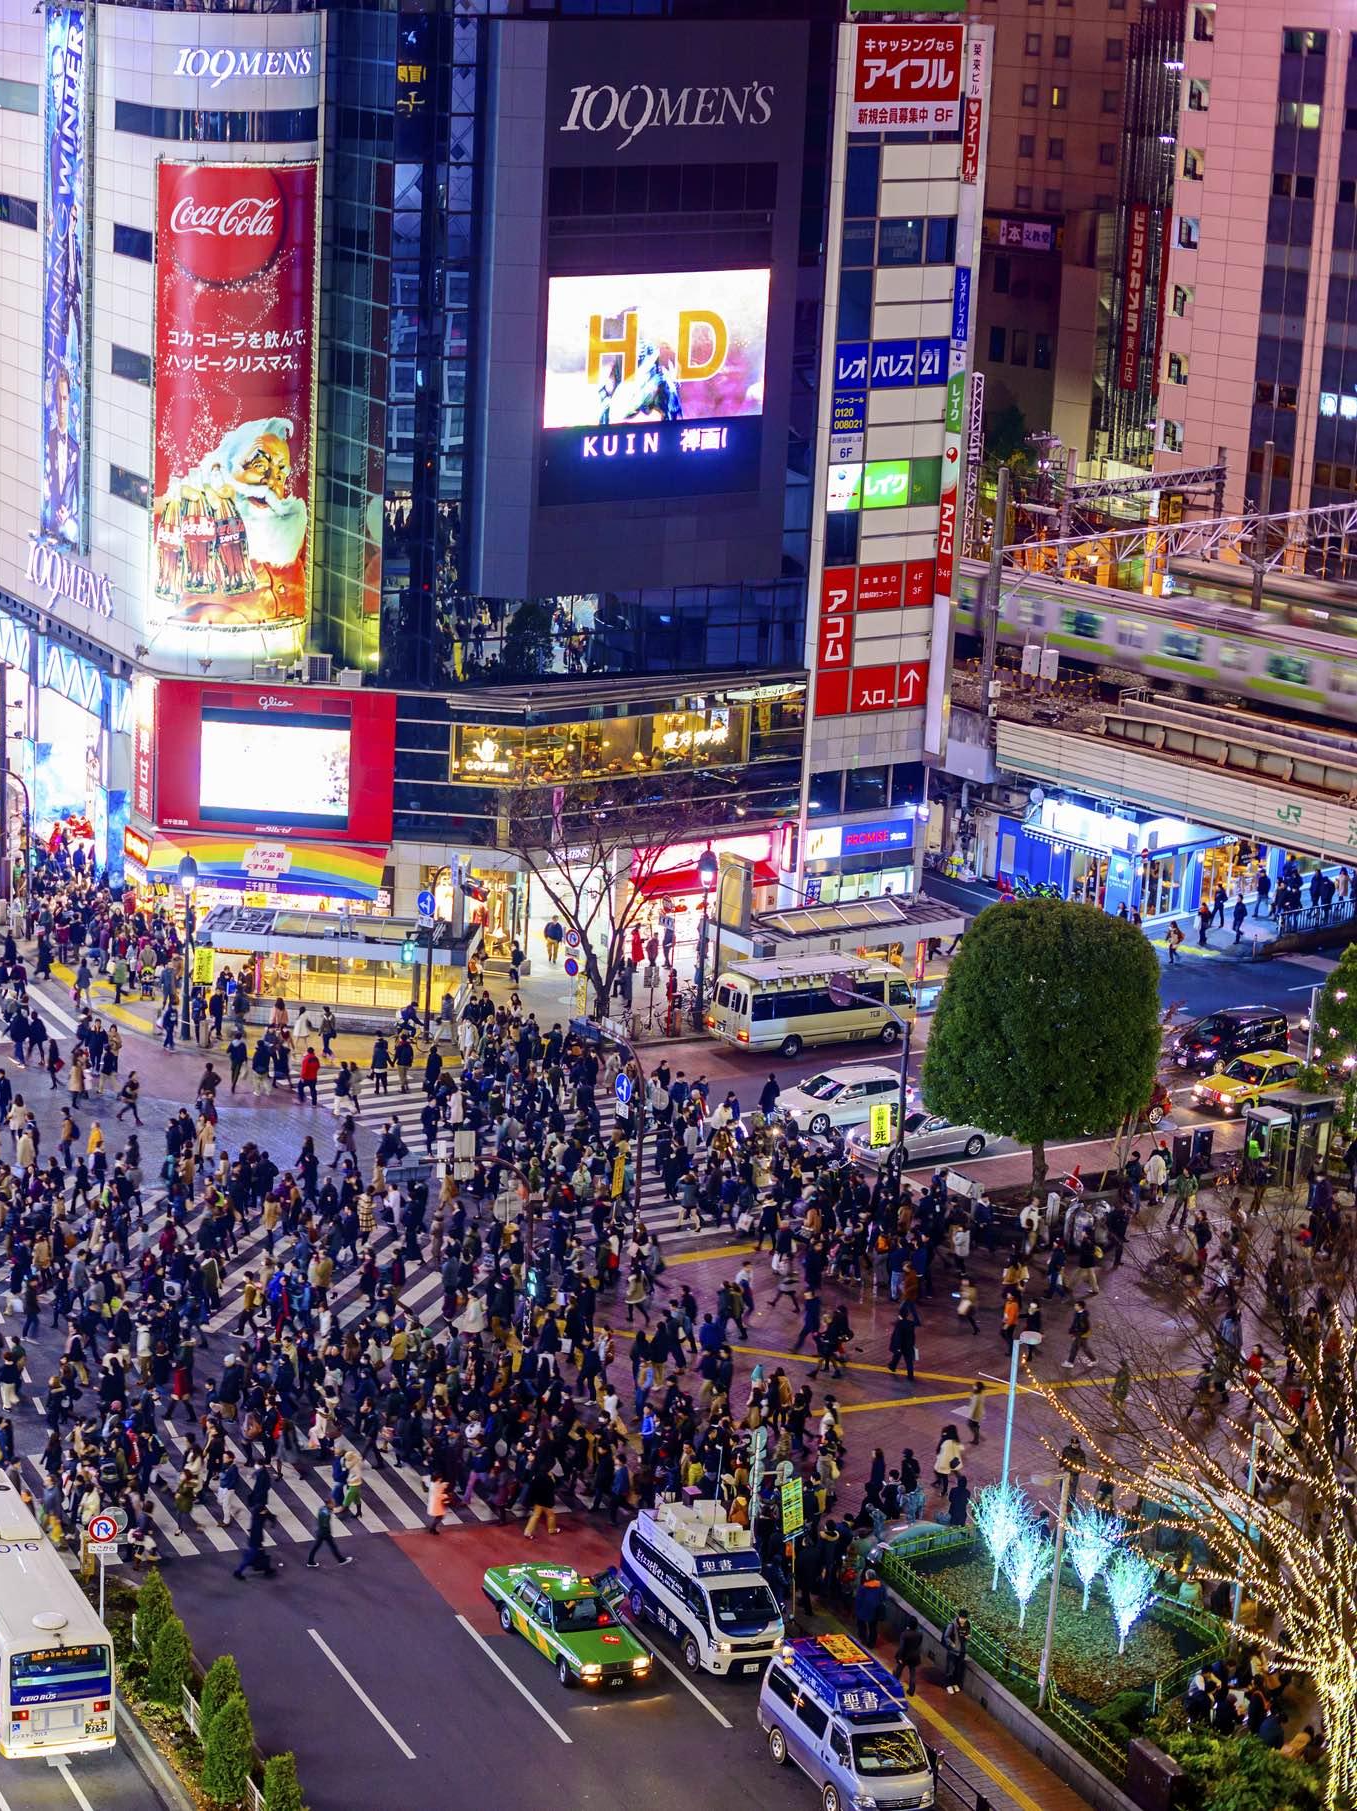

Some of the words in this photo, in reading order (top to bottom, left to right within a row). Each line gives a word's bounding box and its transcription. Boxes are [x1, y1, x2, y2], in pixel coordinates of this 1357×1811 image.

[864, 38, 955, 53] キャッシングなら
[863, 58, 955, 90] アイフル
[857, 106, 929, 125] 新規会員募集中
[934, 107, 954, 122] 8F
[965, 115, 978, 174] アイフル
[170, 196, 281, 236] Coca-Cola
[1007, 226, 1022, 242] 本
[1023, 230, 1050, 243] 文教堂
[1126, 210, 1146, 333] ビックカメラ
[168, 330, 306, 349] コカ・コーラを飲んで、
[167, 354, 300, 372] ハッピークリスマス。
[951, 384, 961, 420] レイク
[834, 407, 854, 418] 0120
[833, 419, 863, 430] 008021
[583, 432, 659, 457] KUIN
[840, 447, 853, 459] 6F
[865, 473, 908, 496] レイク
[940, 503, 954, 555] アコム
[913, 572, 924, 580] 4F
[912, 587, 923, 595] 3F
[824, 589, 848, 662] アコム
[258, 696, 294, 710] Glico
[859, 689, 885, 706] 入口
[1277, 804, 1302, 824] JR
[846, 829, 889, 847] PROMISE
[251, 850, 285, 860] ハチ公前
[702, 1559, 733, 1572] 聖書
[40, 1693, 57, 1701] BUS
[843, 1691, 879, 1711] 聖書
